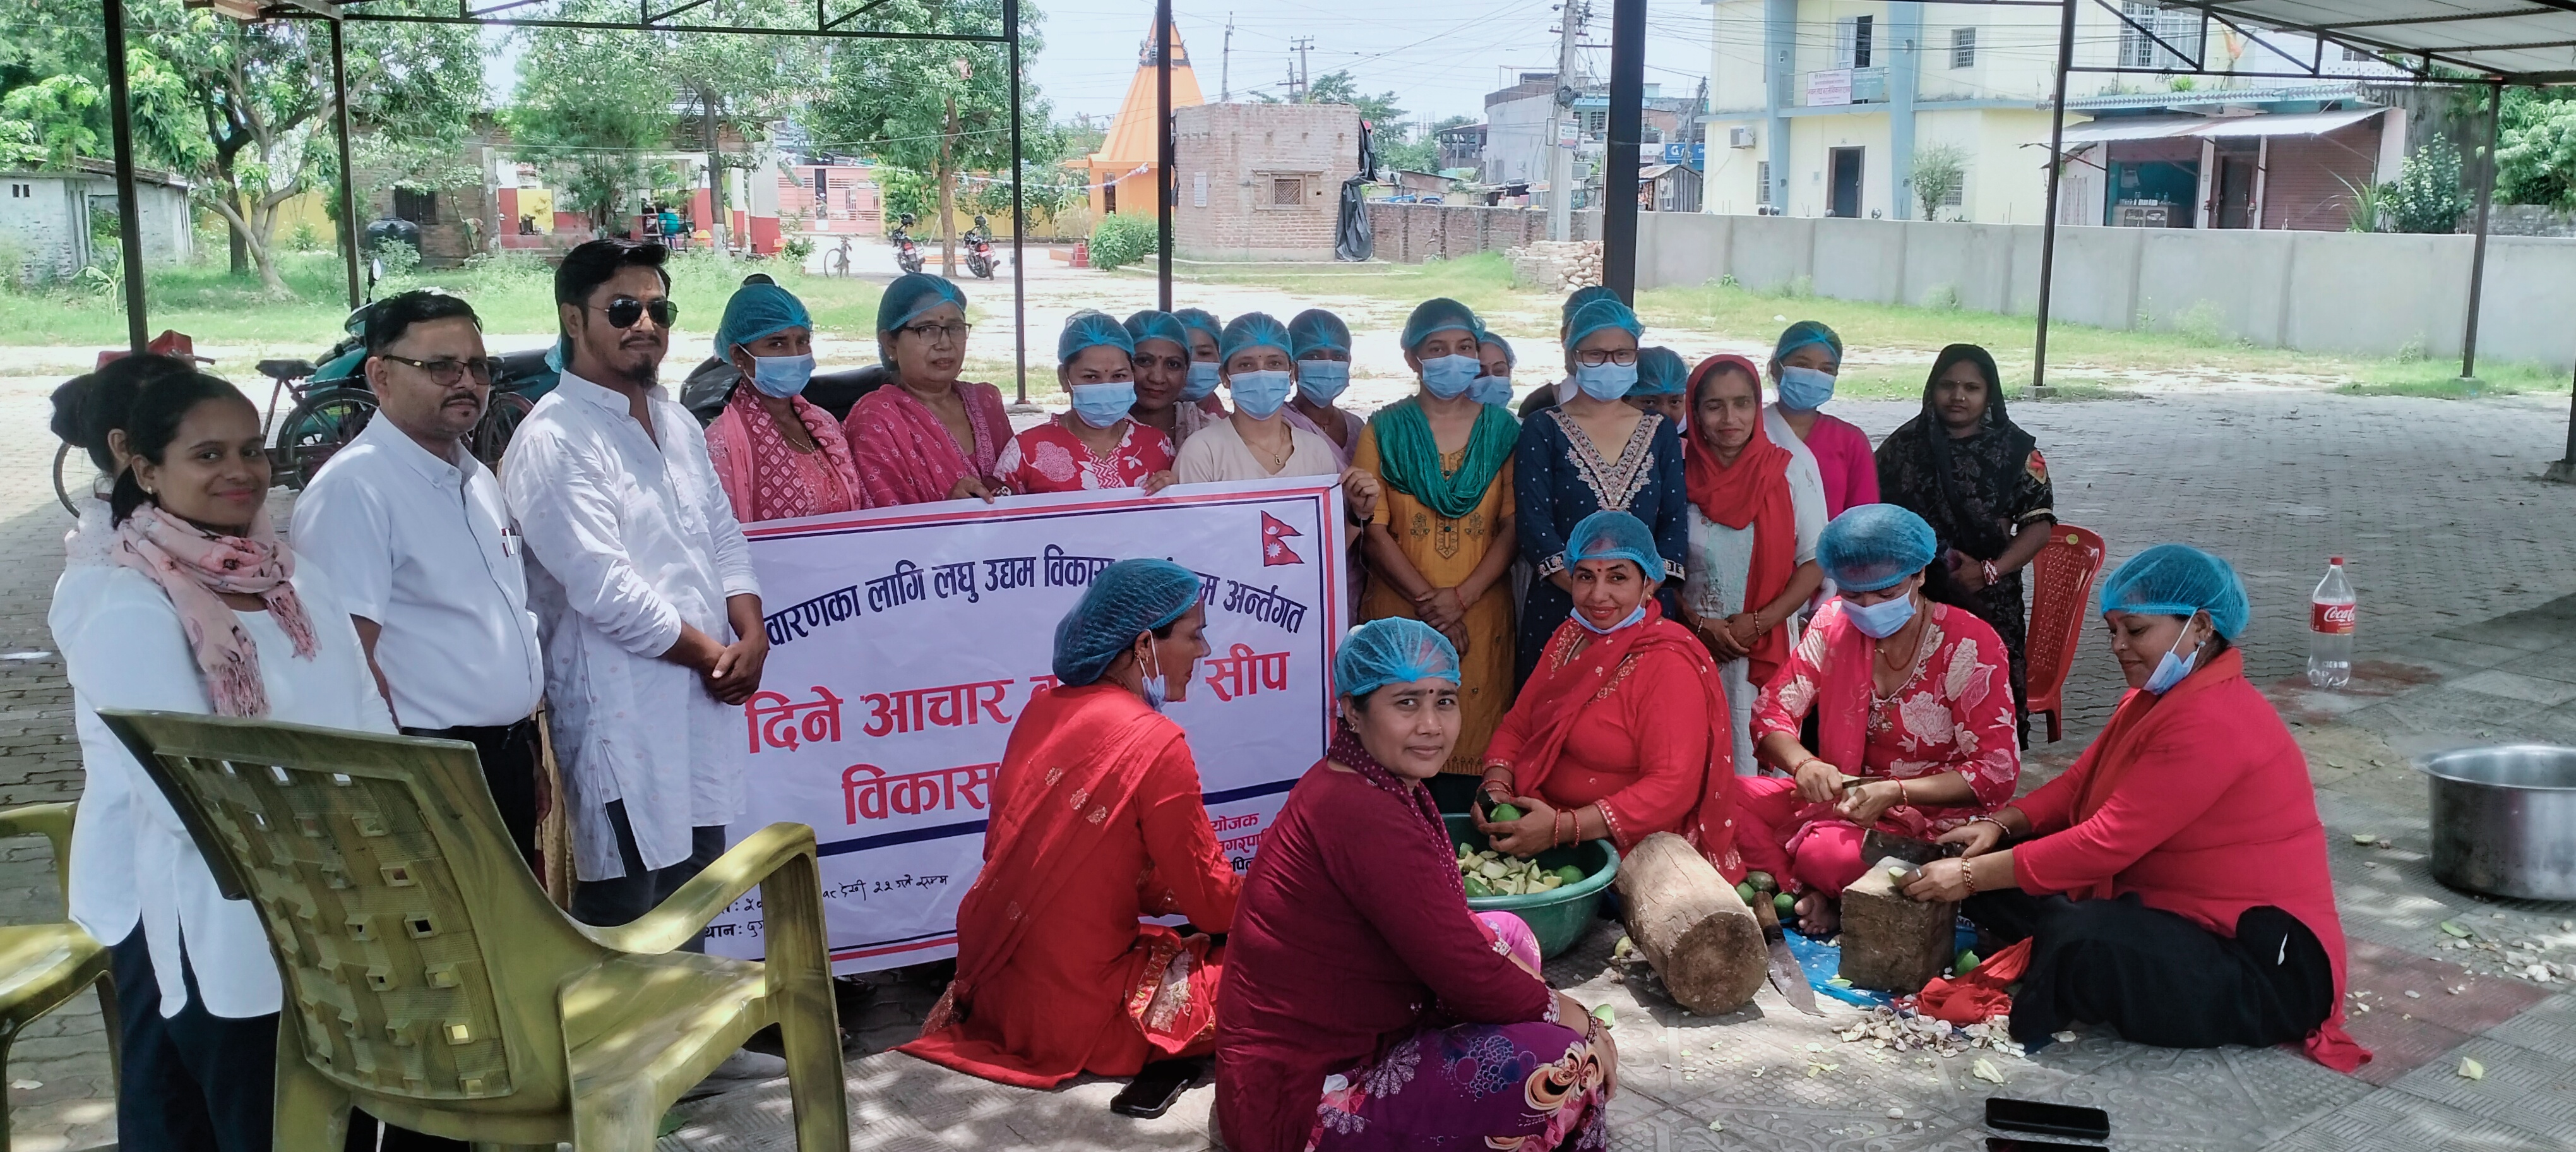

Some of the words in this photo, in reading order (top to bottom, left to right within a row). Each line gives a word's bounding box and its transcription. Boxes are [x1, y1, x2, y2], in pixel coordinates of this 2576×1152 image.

[764, 585, 861, 645] वारणका
[865, 560, 926, 613] लागि
[931, 561, 979, 603] लघु
[745, 685, 844, 753] दिने
[860, 679, 1014, 737] आचार
[1205, 643, 1291, 702] सीप
[842, 762, 1000, 825] विकास
[1210, 813, 1260, 832] योजक
[874, 881, 893, 893] २२
